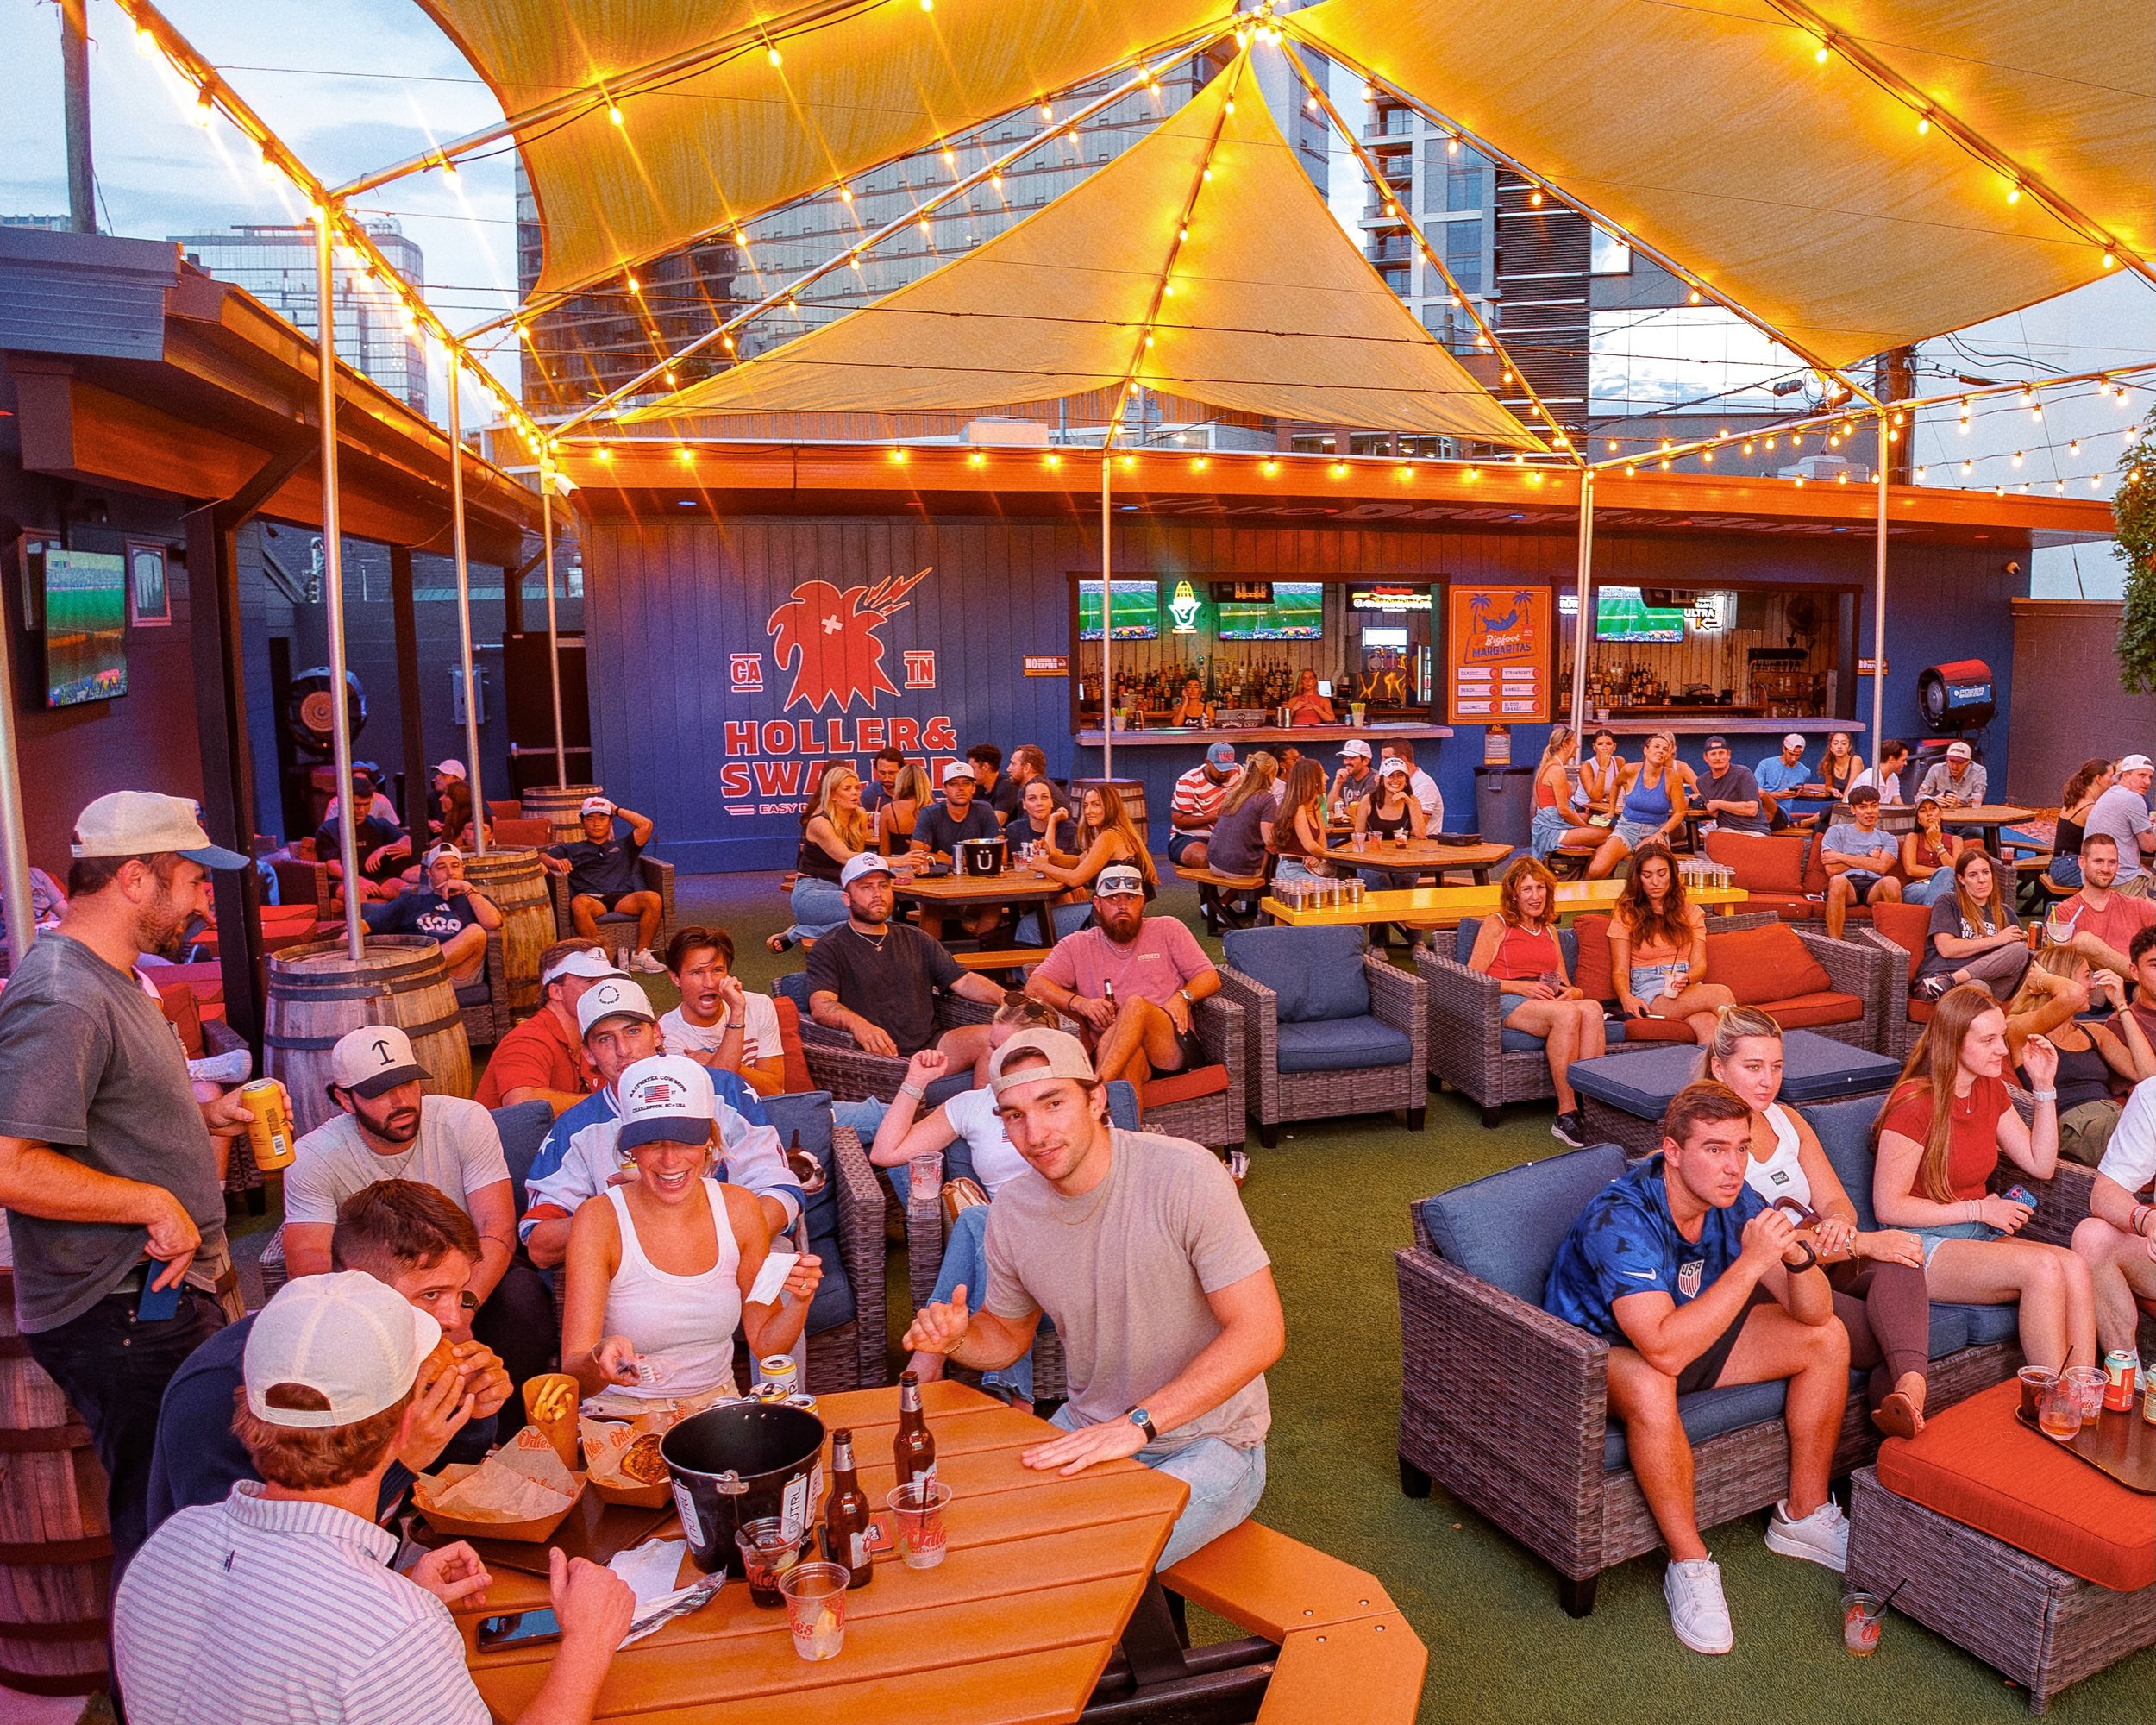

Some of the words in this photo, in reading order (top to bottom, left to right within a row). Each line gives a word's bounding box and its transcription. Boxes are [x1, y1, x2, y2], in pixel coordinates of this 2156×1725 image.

[1683, 608, 1715, 618] ULTRA
[1485, 633, 1520, 646] Bigfoot
[1472, 643, 1532, 657] MARGARITAS
[904, 657, 935, 682] TN
[1025, 658, 1037, 669] NO
[731, 660, 763, 684] CA
[759, 803, 800, 815] EASY
[660, 1076, 687, 1092] COWBOYS
[1682, 1263, 1702, 1276] USA
